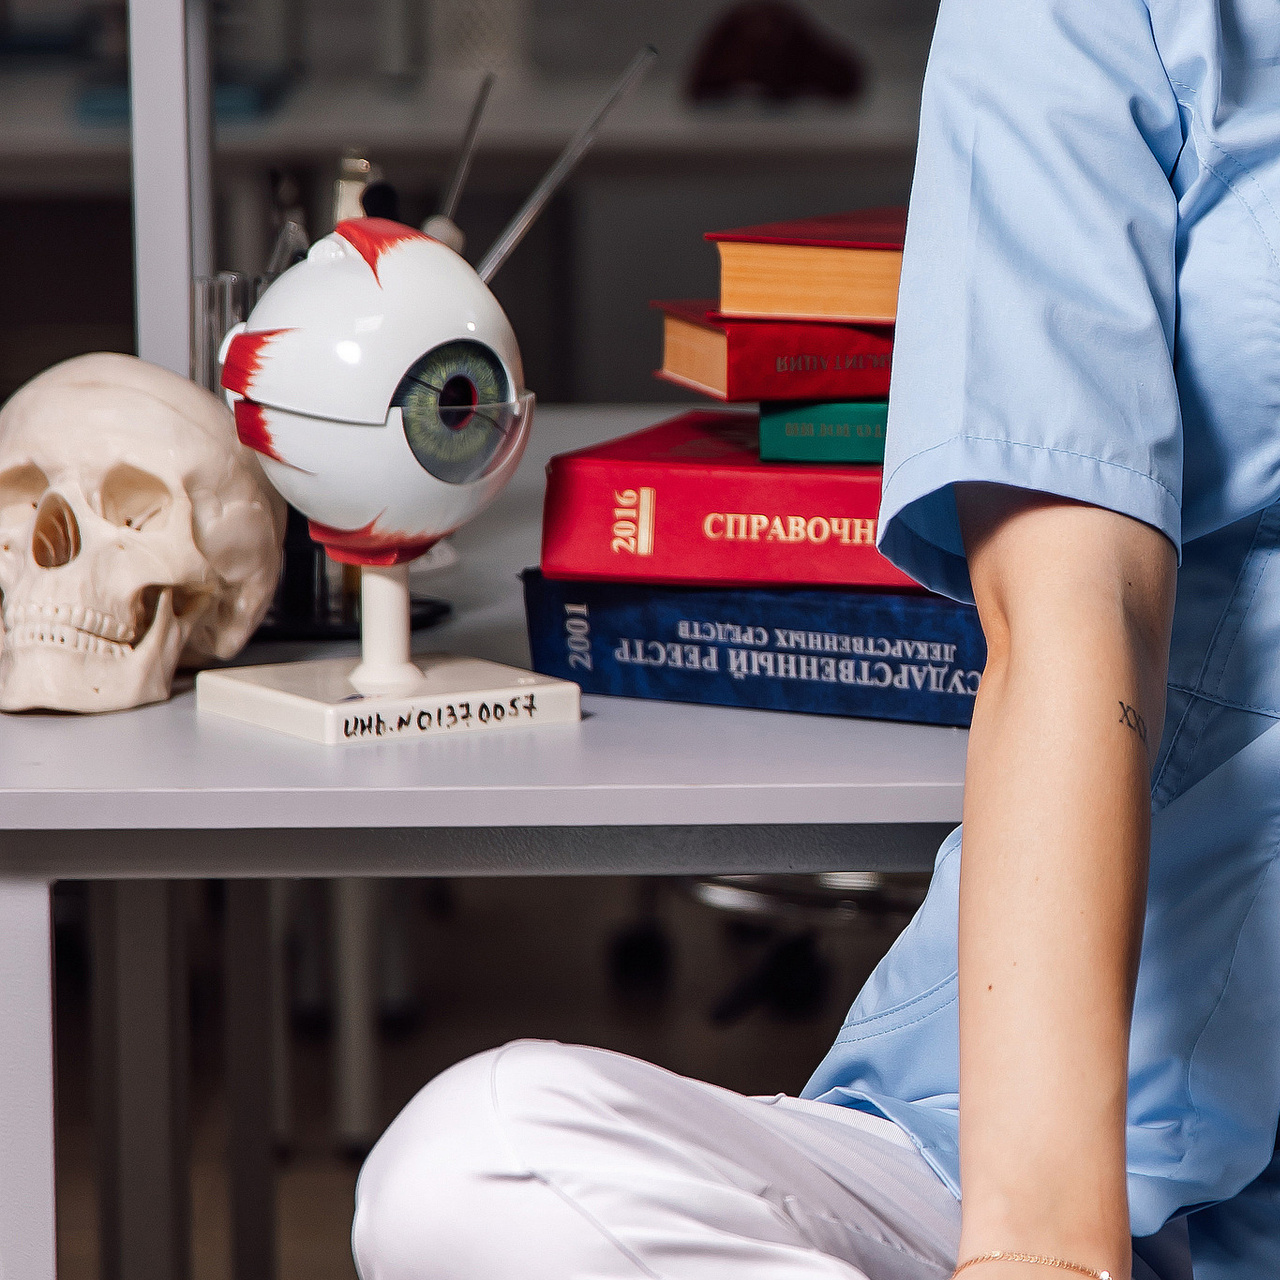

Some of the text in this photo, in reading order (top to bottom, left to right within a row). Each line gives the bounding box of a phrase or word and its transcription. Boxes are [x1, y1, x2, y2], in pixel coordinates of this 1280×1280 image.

[611, 489, 638, 554] 2016
[702, 512, 878, 545] СПРАВОЧН
[564, 602, 593, 670] 2001
[614, 637, 719, 672] РЕЕСТР
[678, 620, 957, 663] ЛЕКАРСТВЕННЫХ СРЕДСТВ
